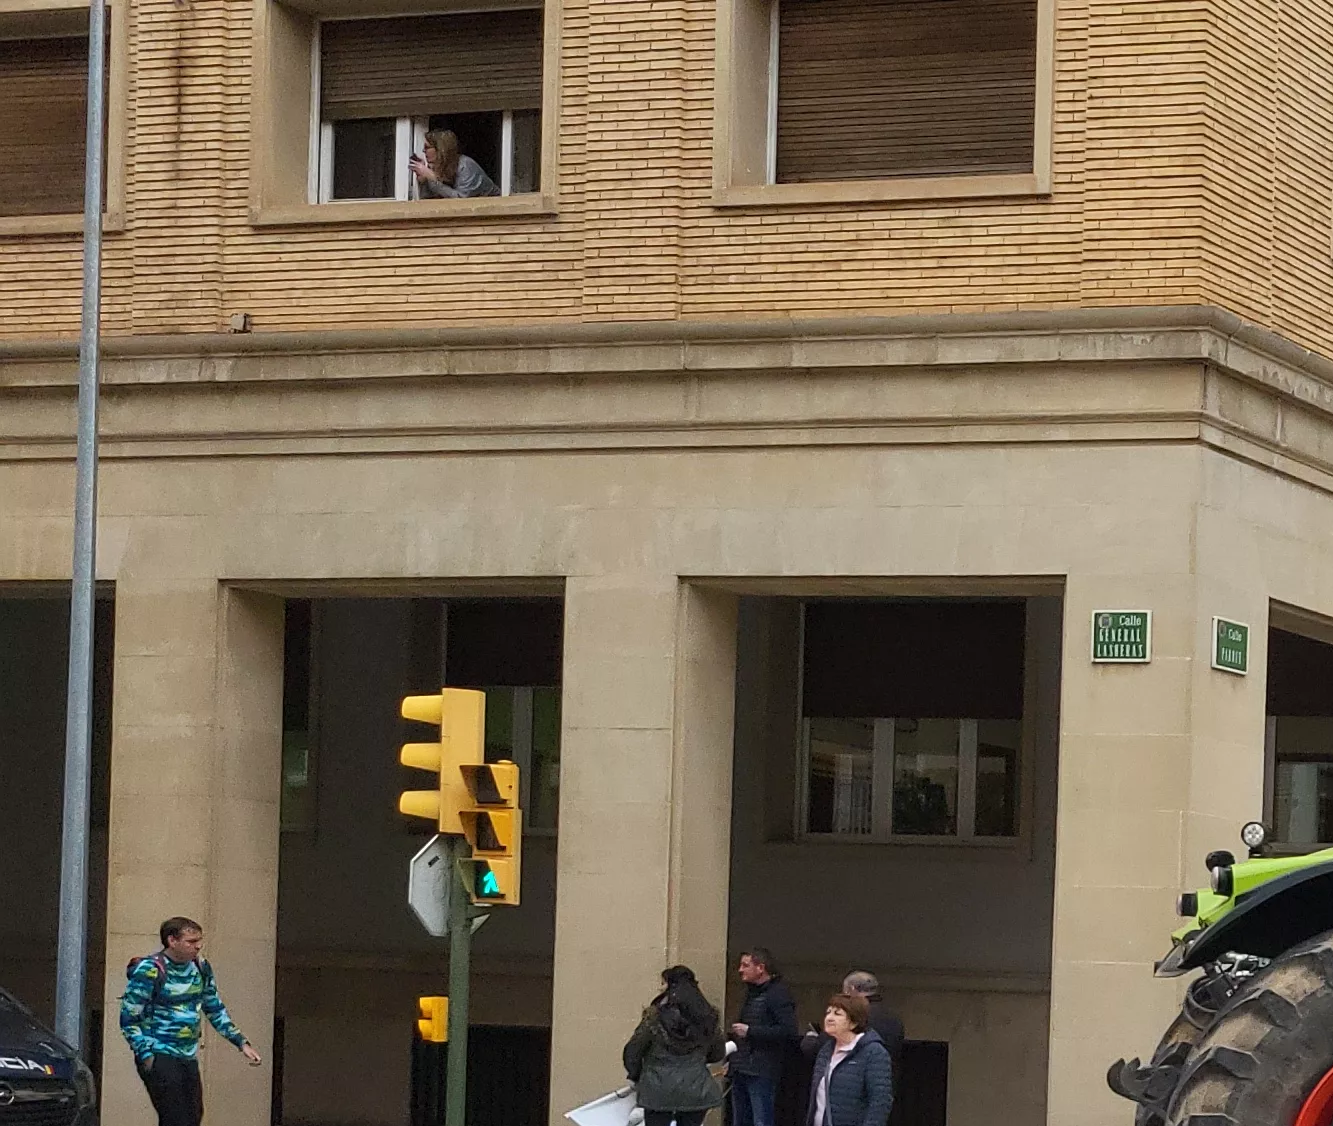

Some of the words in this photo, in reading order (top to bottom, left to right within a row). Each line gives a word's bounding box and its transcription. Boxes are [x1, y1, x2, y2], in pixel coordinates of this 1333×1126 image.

[1119, 615, 1142, 626] Calle
[1099, 628, 1141, 642] GENERAL
[1097, 644, 1143, 658] LASHERAS
